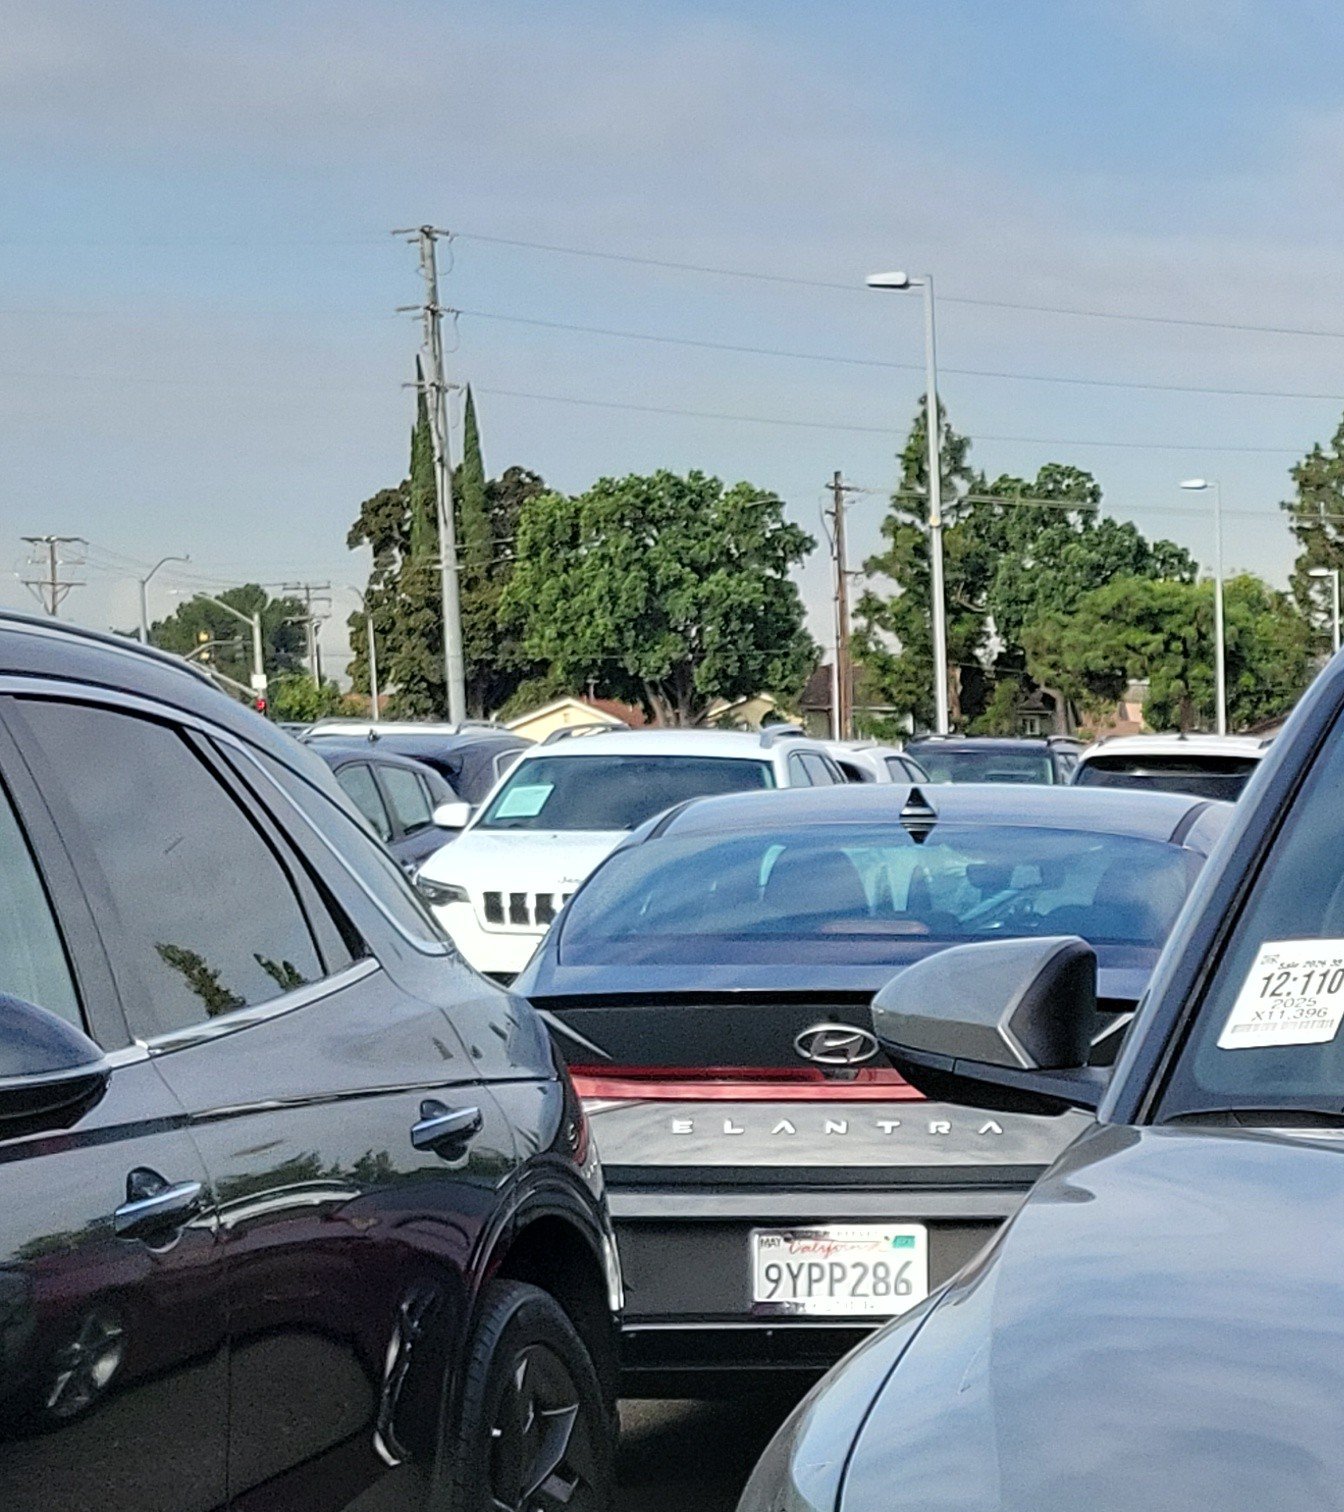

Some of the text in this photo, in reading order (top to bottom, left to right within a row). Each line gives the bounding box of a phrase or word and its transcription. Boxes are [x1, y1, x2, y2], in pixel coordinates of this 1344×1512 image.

[1271, 997, 1317, 1009] 2025
[672, 1119, 1003, 1135] ELANTRA
[765, 1260, 913, 1299] 9YPP286
